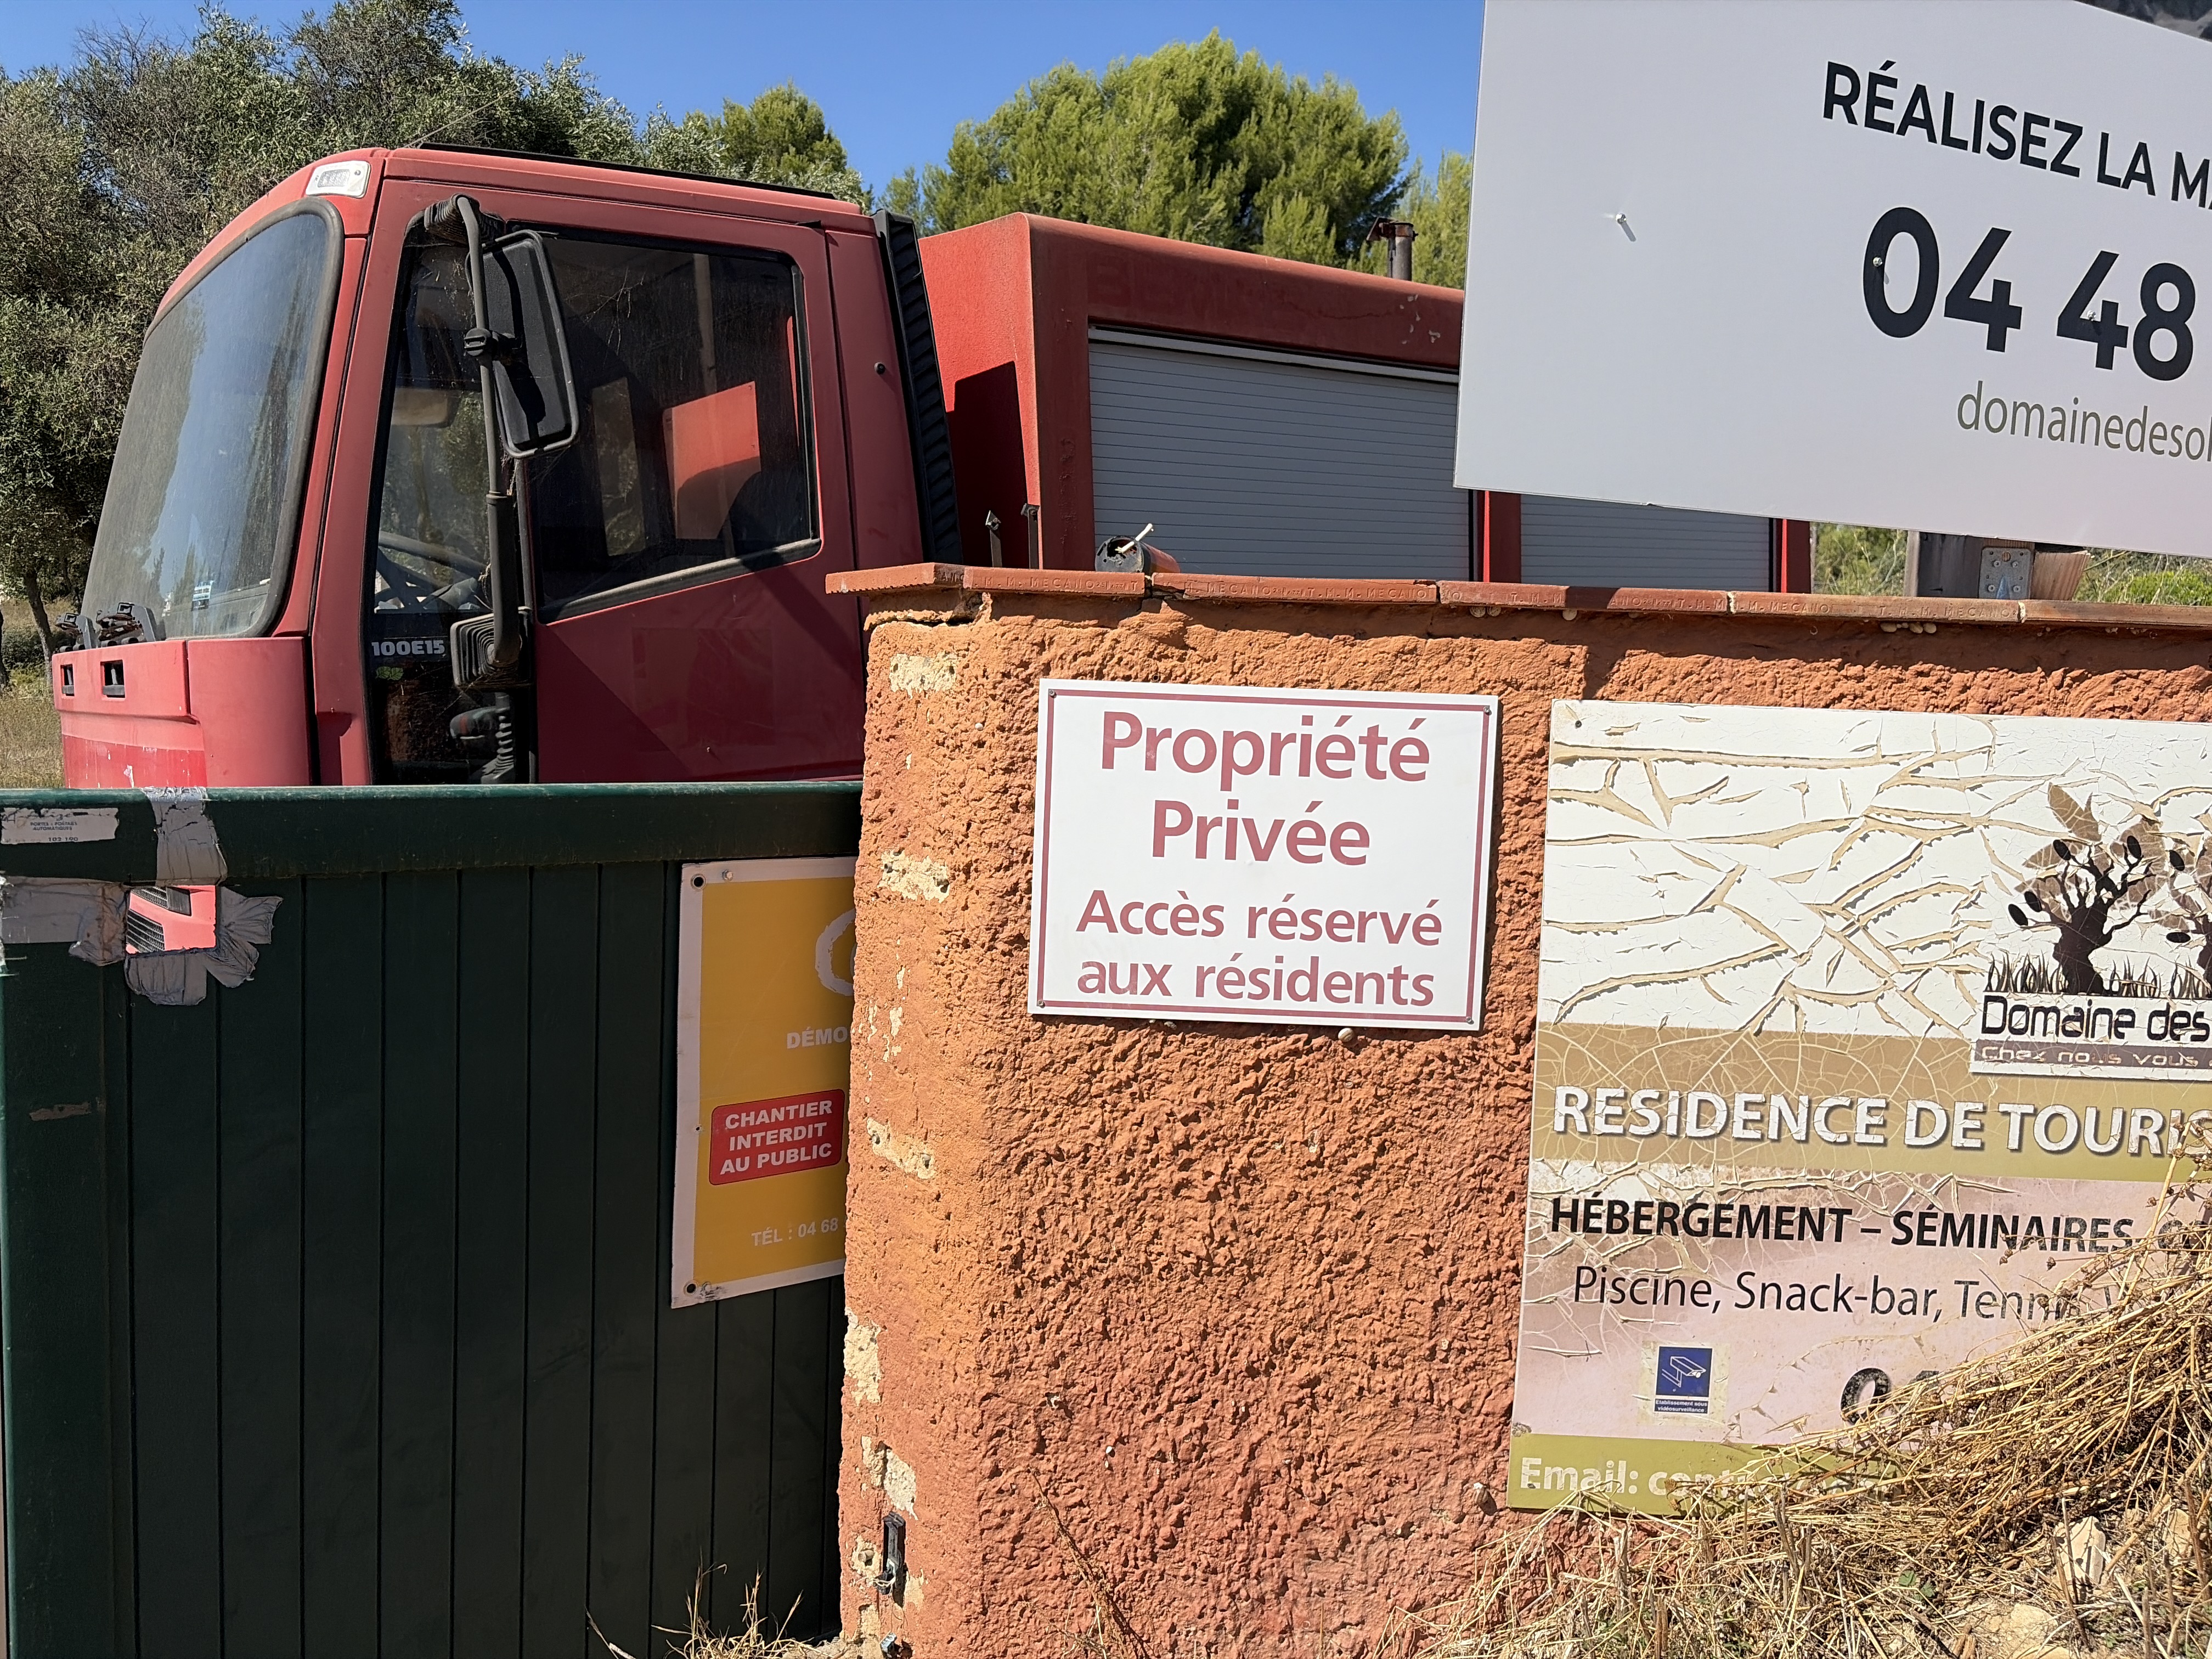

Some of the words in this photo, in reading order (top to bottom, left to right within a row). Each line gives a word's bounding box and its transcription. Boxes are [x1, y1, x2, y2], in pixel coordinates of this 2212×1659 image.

[1822, 60, 2084, 178] RÉALISEZ
[2097, 132, 2156, 196] LA
[2171, 151, 2212, 210] M
[1863, 206, 2023, 353] 04
[2056, 250, 2196, 381] 48
[1956, 380, 2212, 462] domainedesol
[371, 640, 445, 656] 100E15
[1101, 711, 1430, 792] Propriété
[1152, 799, 1370, 866] Privée
[1075, 890, 1225, 938] Accès
[1248, 893, 1442, 946] réservé
[1077, 959, 1173, 997] aux
[1195, 952, 1435, 1006] résidents
[787, 1026, 848, 1049] DÉMO
[1982, 995, 2135, 1037] Domaine
[2147, 1002, 2210, 1042] des
[2057, 1051, 2122, 1064] nous
[2132, 1053, 2199, 1067] vous
[725, 1100, 832, 1131] CHANTIER
[729, 1122, 828, 1152] INTERDIT
[1553, 1085, 1888, 1146] RESIDENCE
[1904, 1098, 1985, 1149] DE
[720, 1156, 750, 1176] AU
[757, 1142, 832, 1169] PUBLIC
[751, 1226, 783, 1246] TÉL
[798, 1221, 816, 1238] 04
[821, 1217, 838, 1233] 68
[1550, 1192, 1853, 1243] HÉBERGEMENT
[1891, 1204, 2134, 1254] SÉMINAIRES
[1573, 1265, 1720, 1316] Piscine,
[1735, 1269, 1942, 1324] Snack-bar,
[1520, 1457, 1639, 1495] Email:
